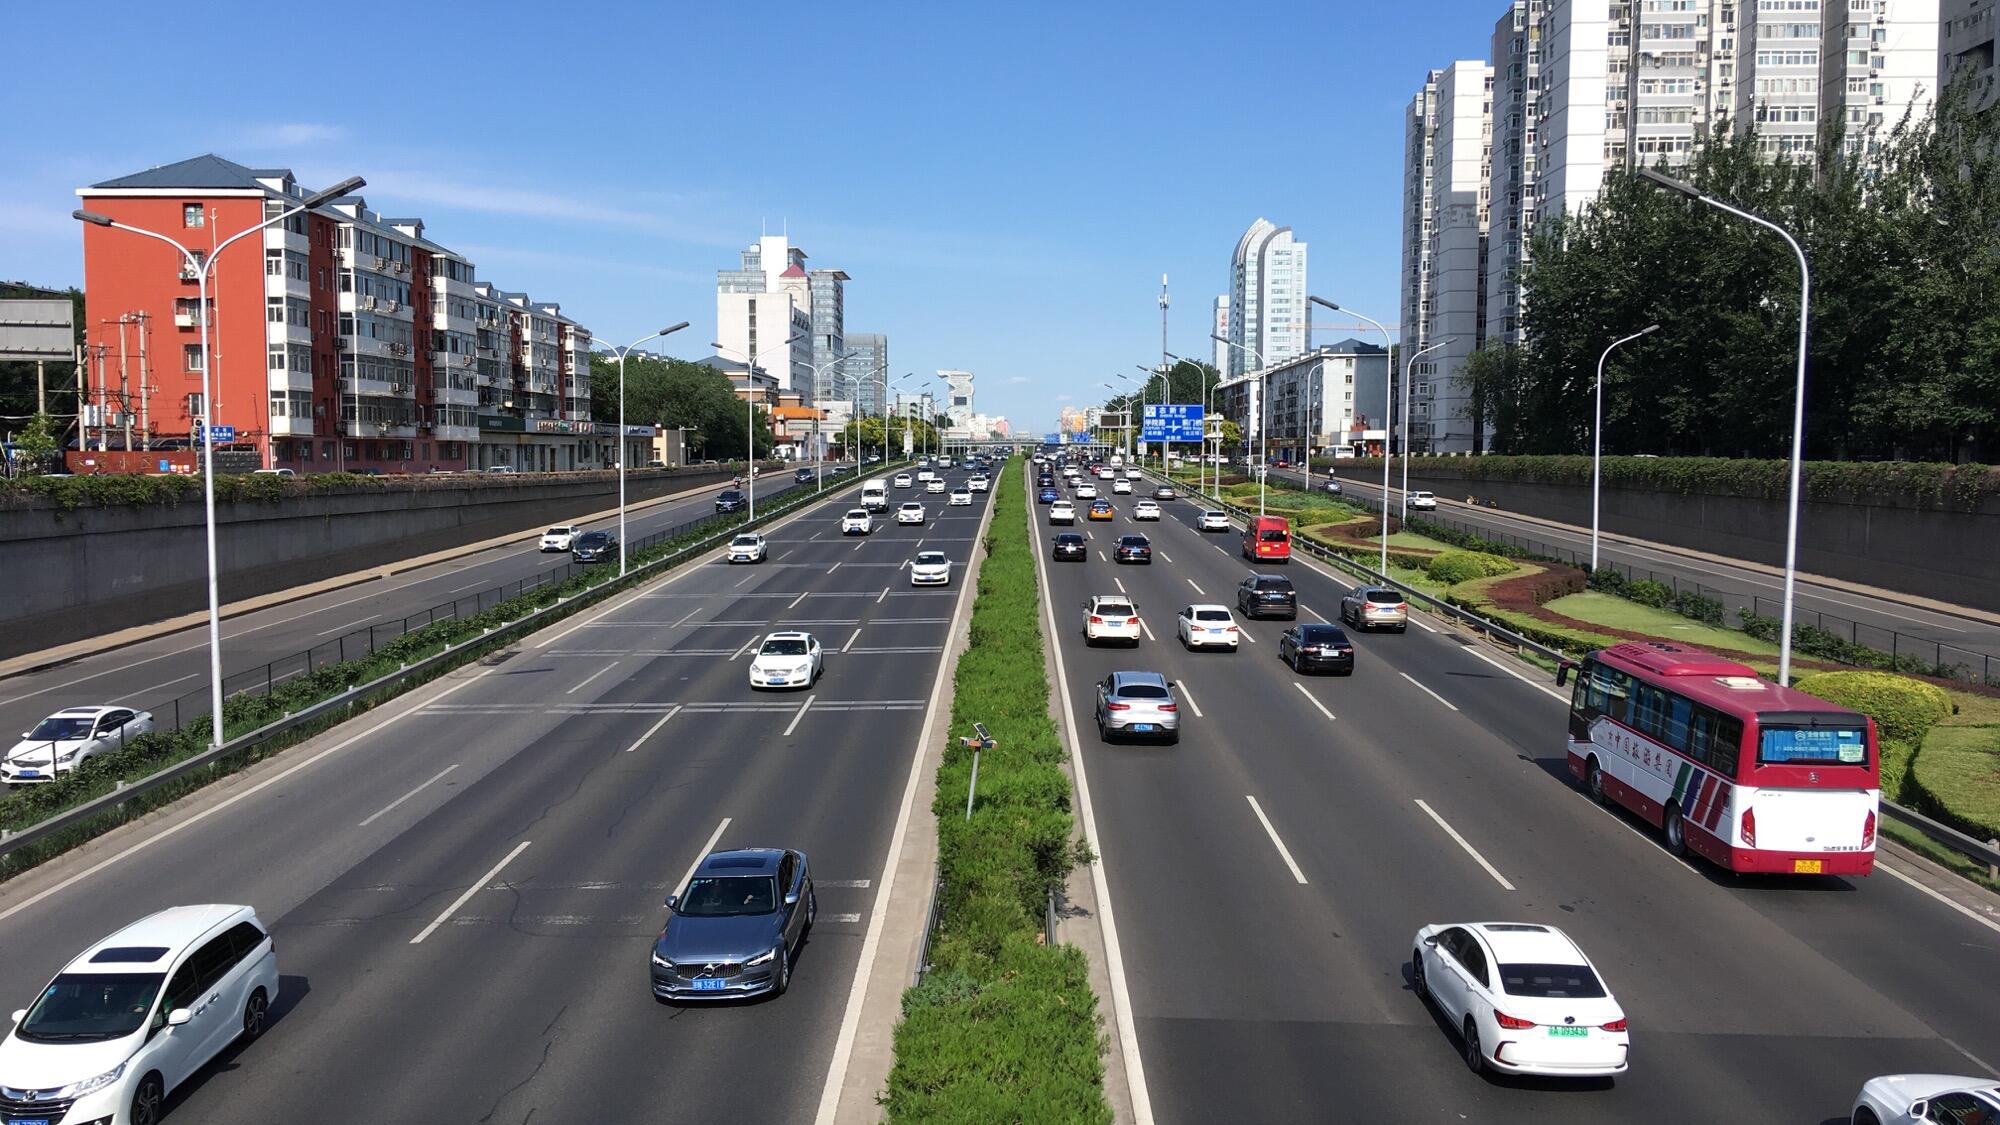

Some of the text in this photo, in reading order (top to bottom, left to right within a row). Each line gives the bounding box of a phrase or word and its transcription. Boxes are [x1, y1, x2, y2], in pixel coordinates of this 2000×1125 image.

[1615, 730, 1673, 778] 中国旅游集团
